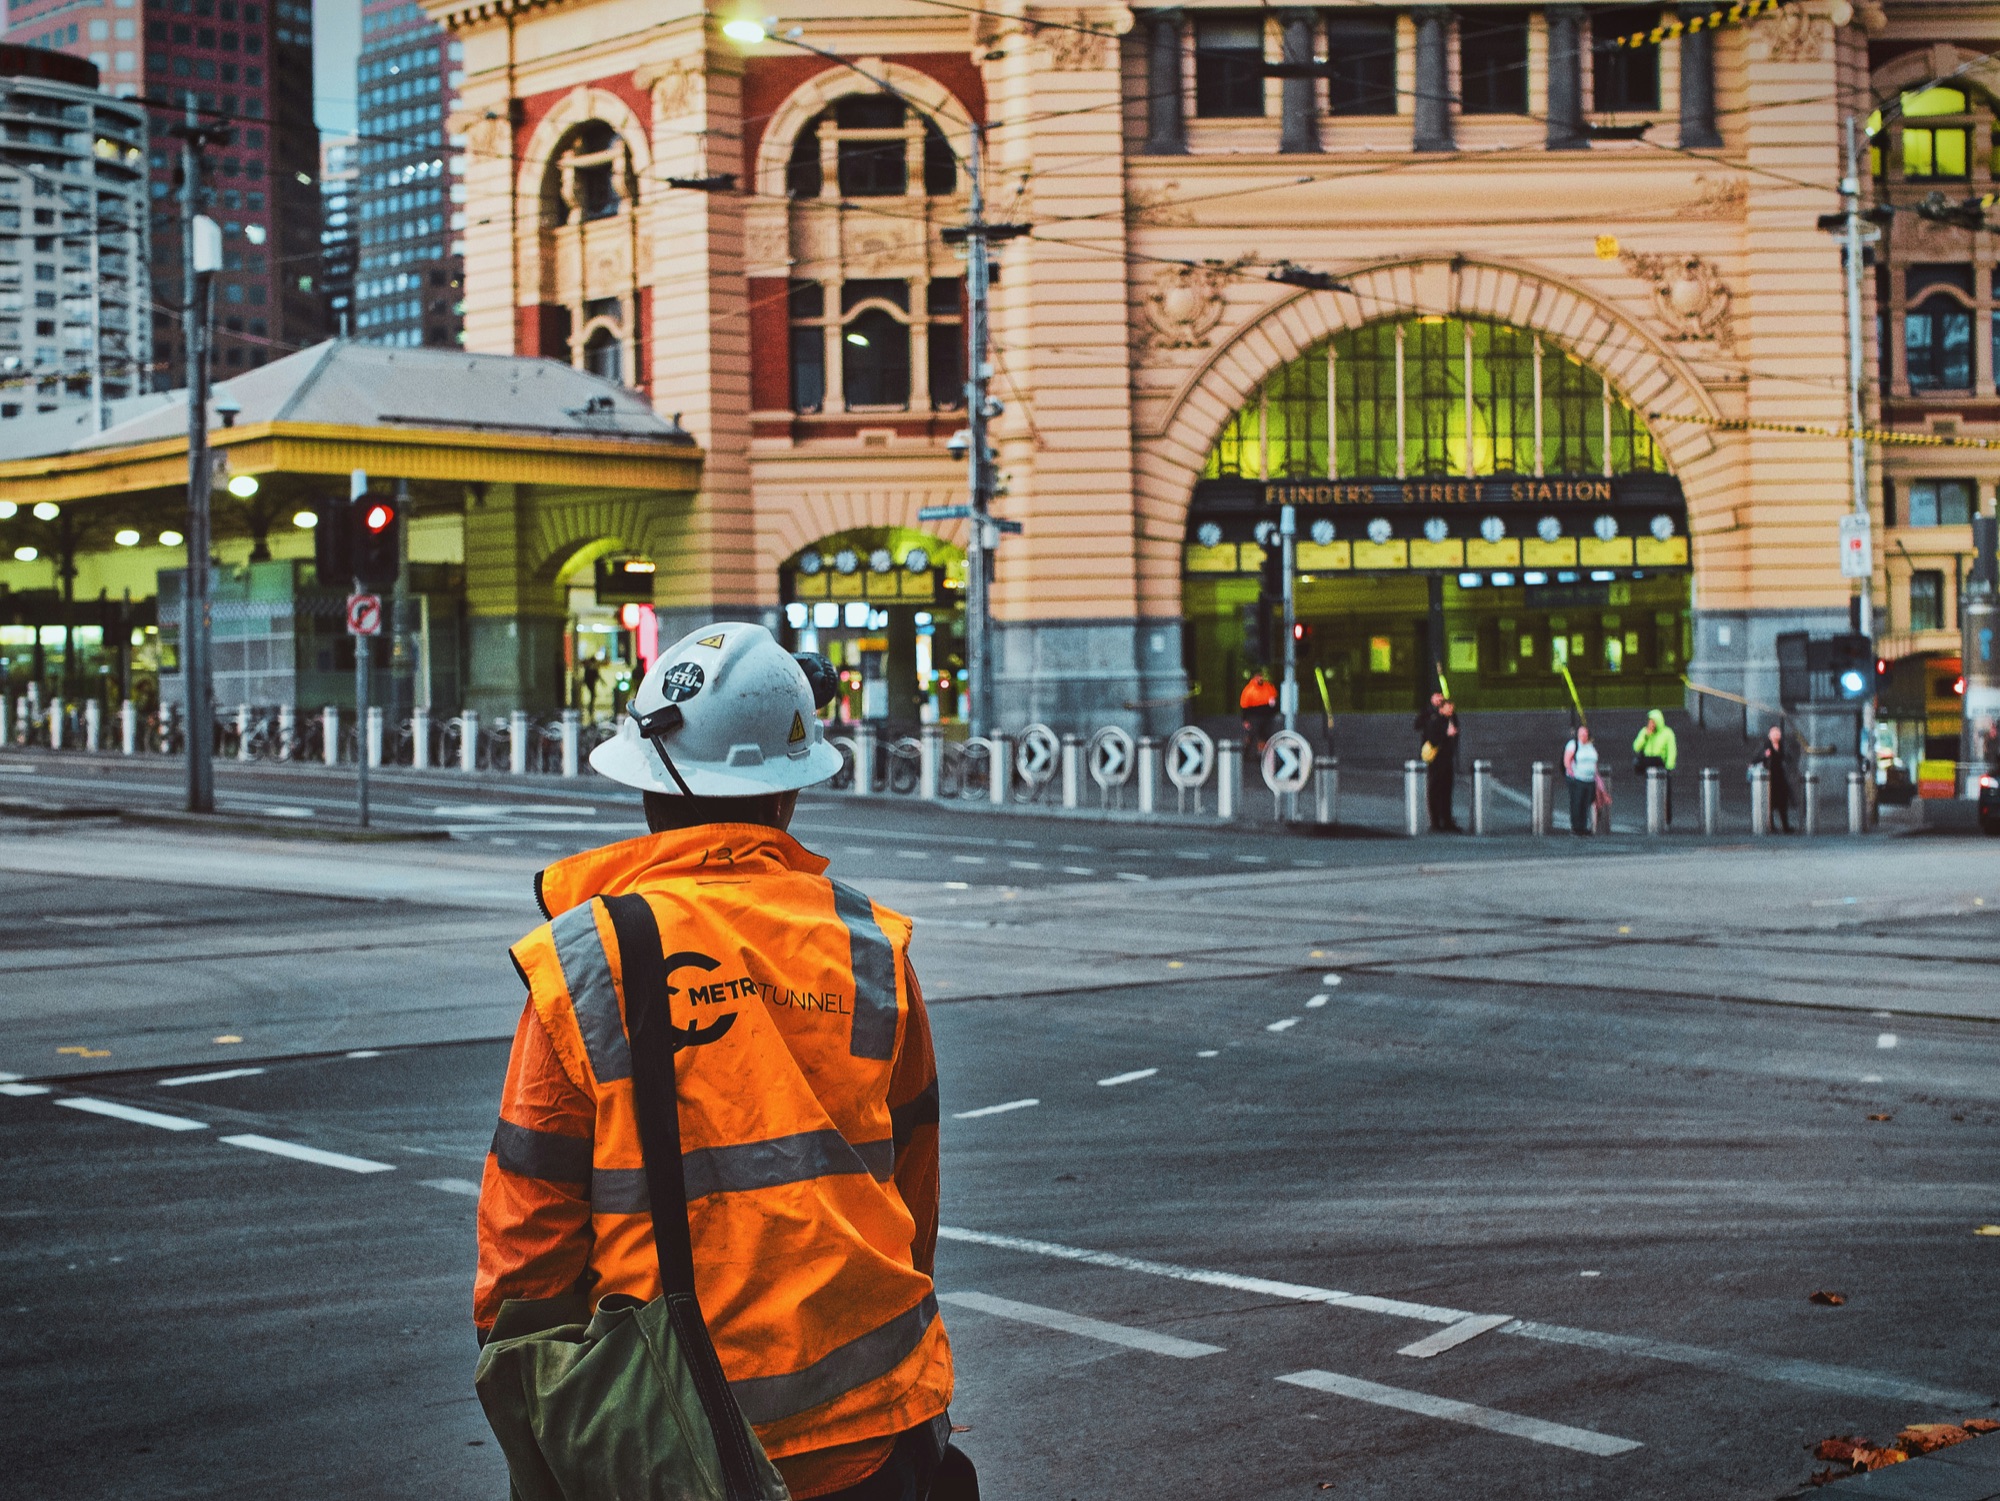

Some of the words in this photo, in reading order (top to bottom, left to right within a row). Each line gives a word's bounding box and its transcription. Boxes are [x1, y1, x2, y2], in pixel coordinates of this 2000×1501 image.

[1265, 484, 1374, 504] FLINDERS
[1402, 483, 1483, 503] STREET
[1511, 481, 1611, 501] STATION
[671, 671, 697, 687] ETU
[758, 982, 851, 1015] TUNNEL
